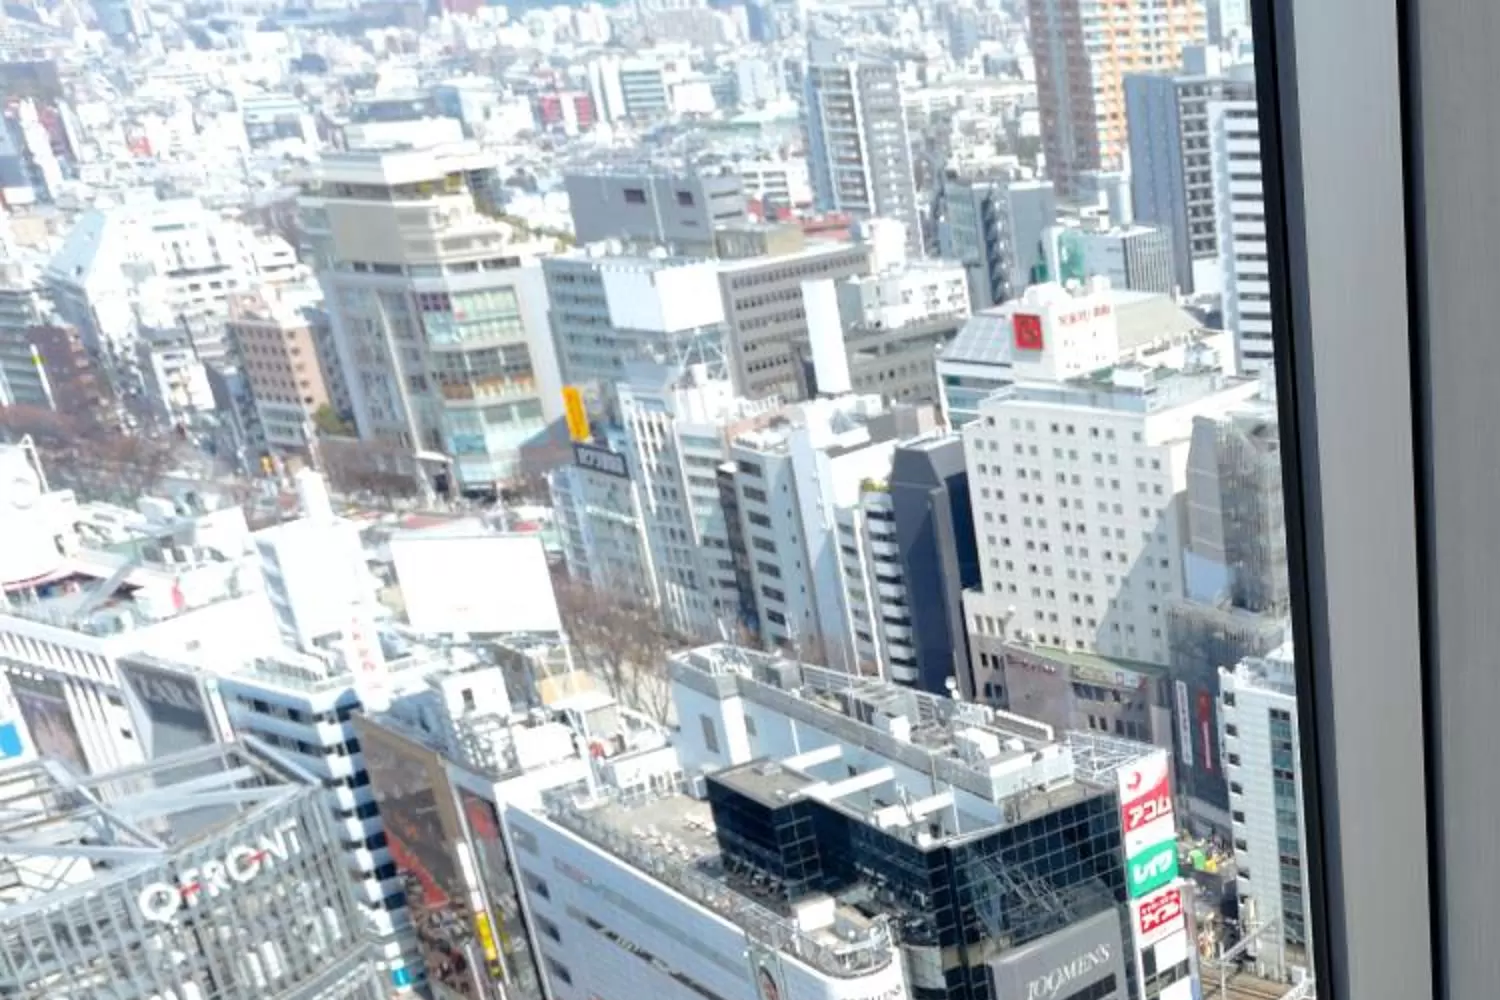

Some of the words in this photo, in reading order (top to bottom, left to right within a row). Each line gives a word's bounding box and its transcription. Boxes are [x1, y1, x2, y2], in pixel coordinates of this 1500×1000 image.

[1128, 796, 1172, 829] アコム
[139, 816, 300, 928] QFRONT
[1134, 850, 1172, 884] レイク
